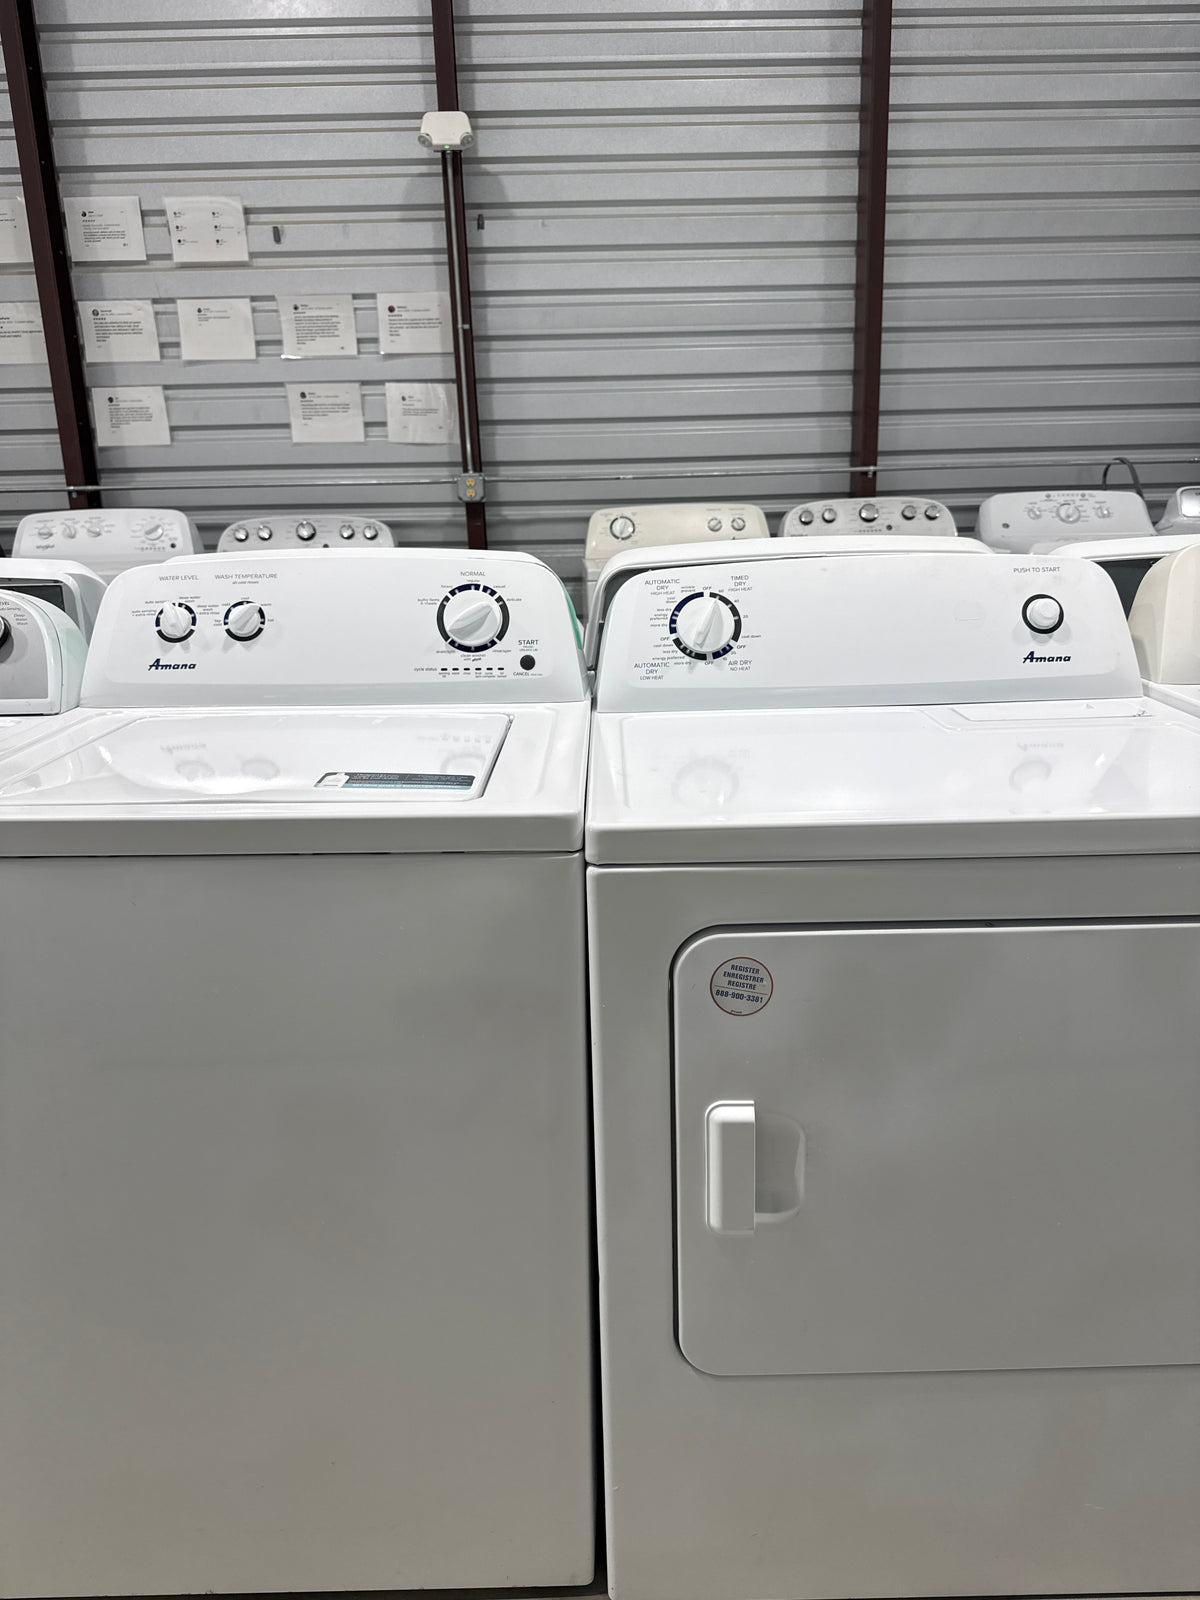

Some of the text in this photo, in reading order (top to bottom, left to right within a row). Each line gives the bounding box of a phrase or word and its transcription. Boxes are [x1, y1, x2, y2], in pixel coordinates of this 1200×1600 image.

[1023, 651, 1071, 663] Amana
[148, 658, 197, 671] Amana
[730, 964, 760, 974] REGISTER
[723, 971, 764, 983] ENREGISTRER
[728, 980, 757, 990] REGISTRE
[715, 989, 763, 1003] 888-900-3381
